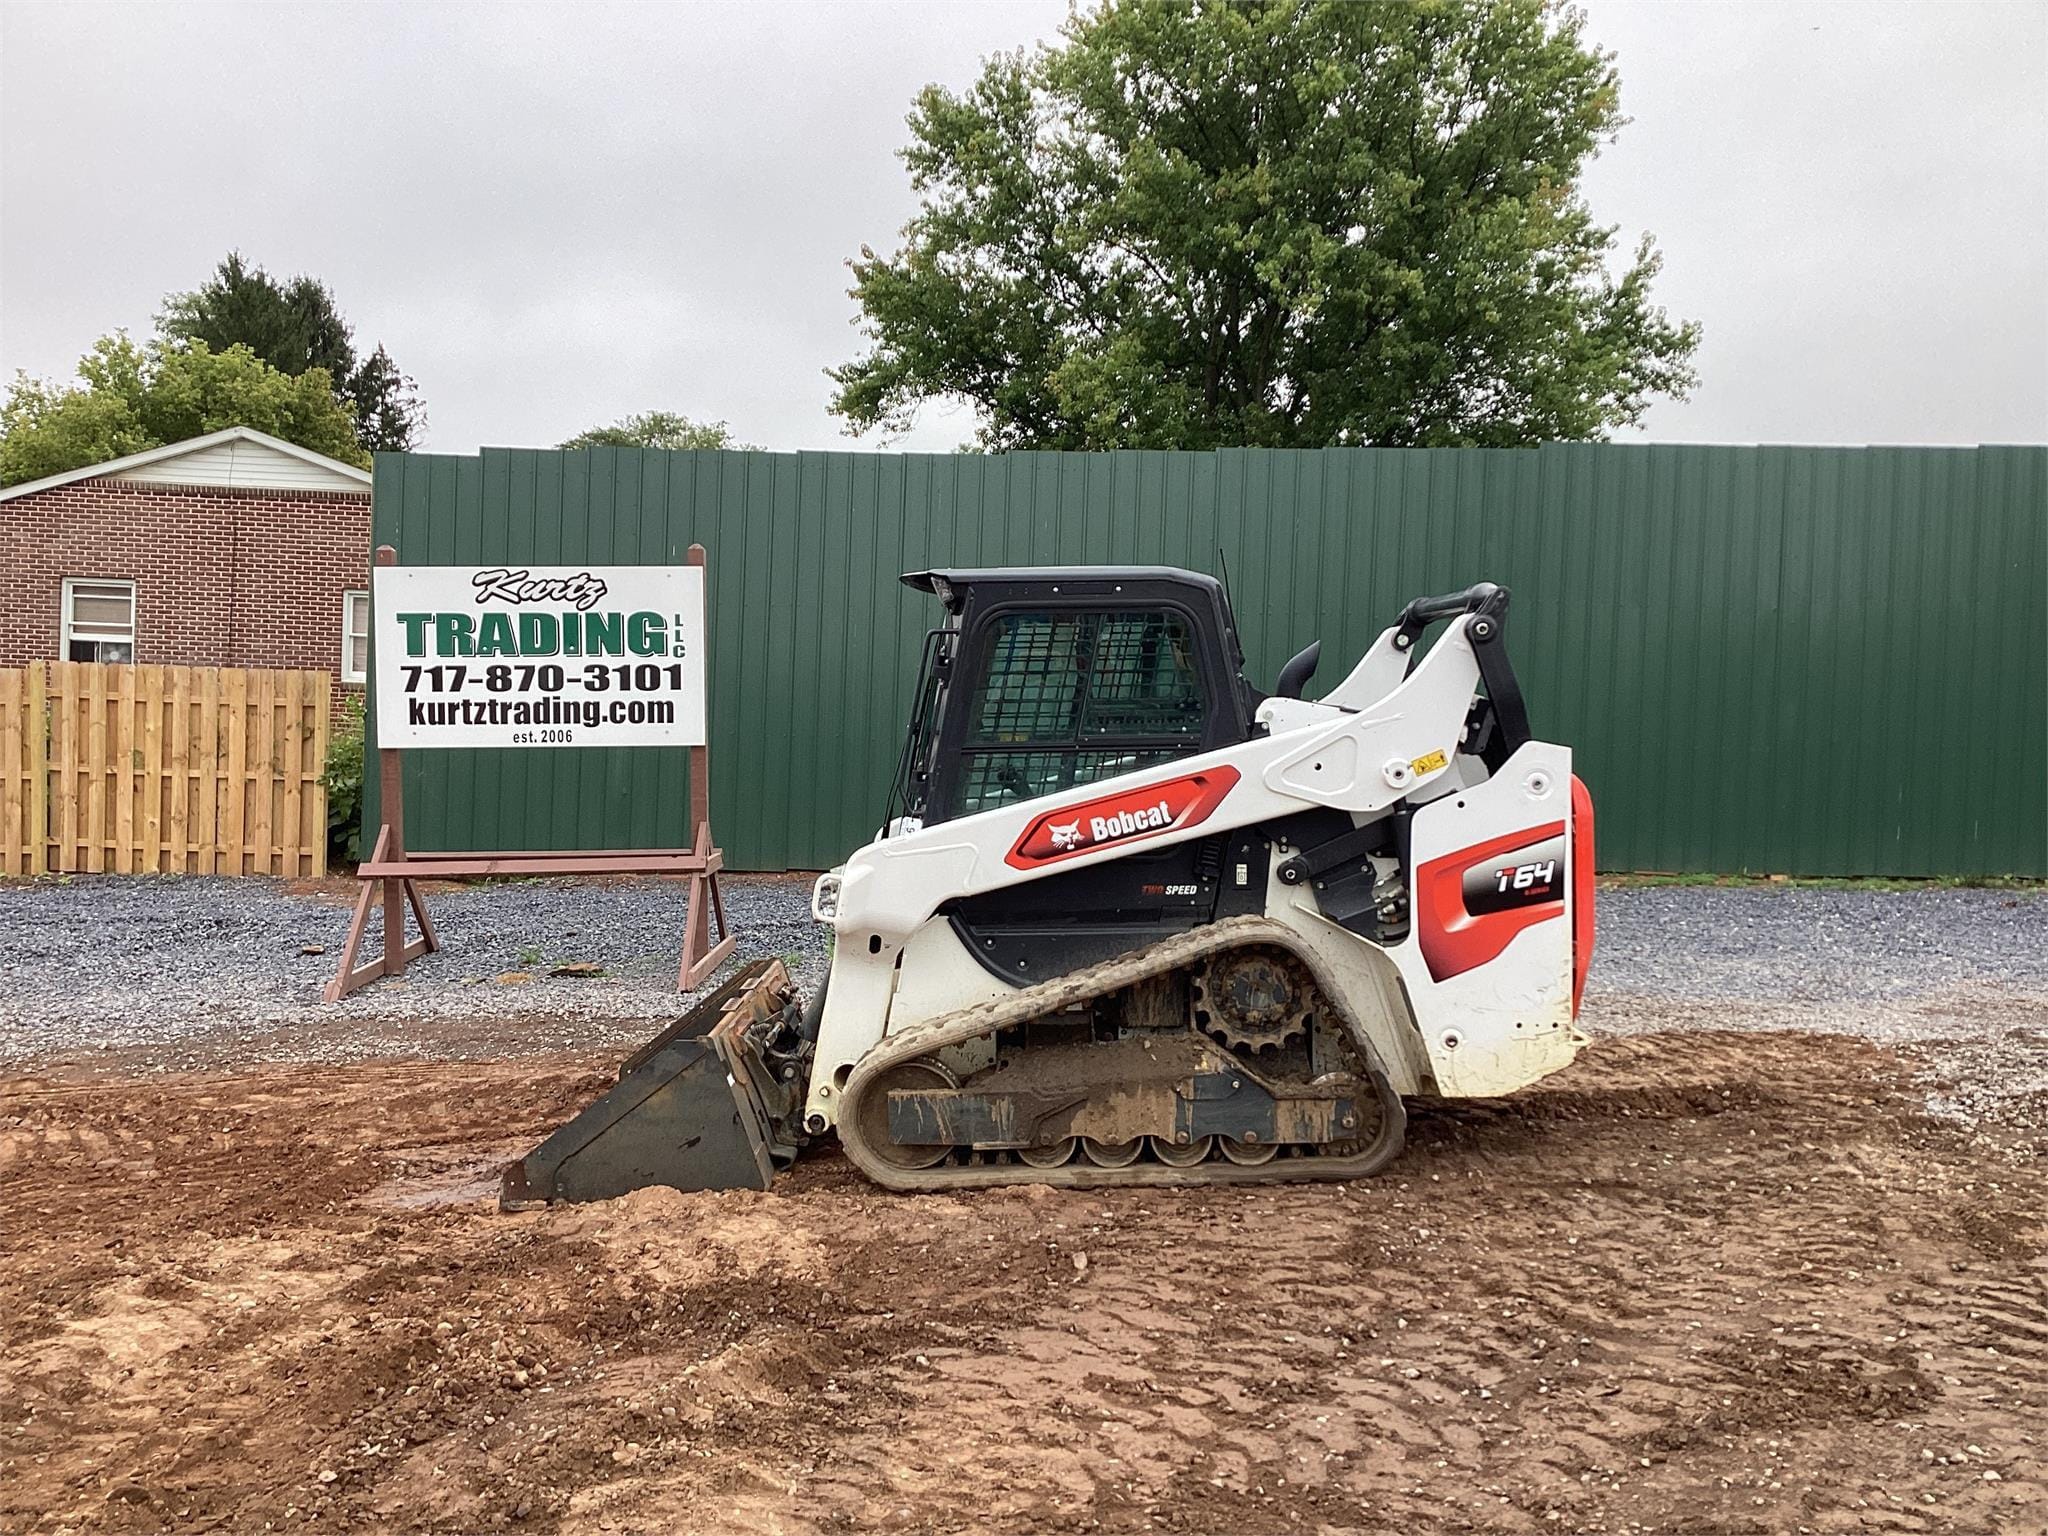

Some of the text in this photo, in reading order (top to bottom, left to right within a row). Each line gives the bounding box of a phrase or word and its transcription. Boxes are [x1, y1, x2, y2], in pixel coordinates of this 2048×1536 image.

[472, 569, 608, 611] Kurtz
[396, 611, 668, 658] TRADING
[673, 613, 686, 658] LLC
[400, 663, 682, 693] 717-870-3101
[409, 696, 674, 727] kurtztrading.com
[513, 729, 573, 744] est. 2006
[1090, 800, 1173, 842] Bobcat
[1142, 884, 1198, 896] TWO SPEED
[1495, 859, 1556, 893] T64
